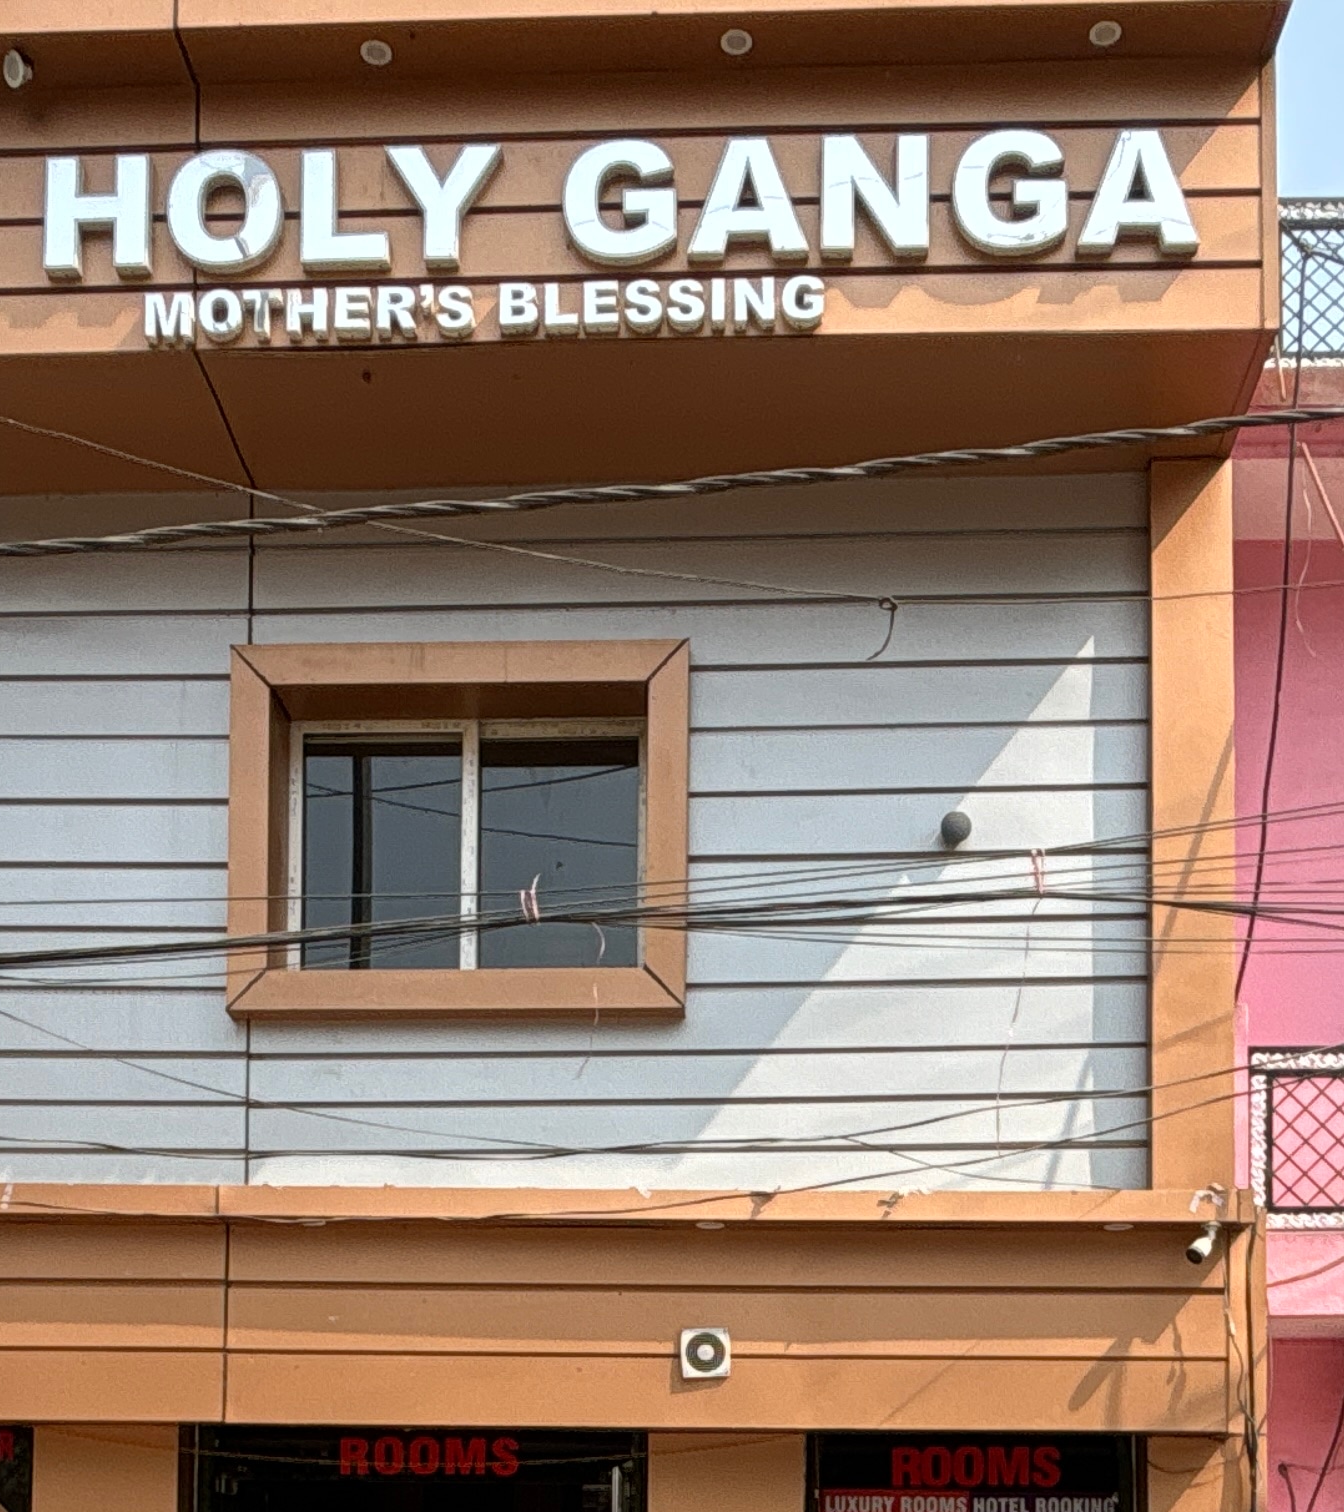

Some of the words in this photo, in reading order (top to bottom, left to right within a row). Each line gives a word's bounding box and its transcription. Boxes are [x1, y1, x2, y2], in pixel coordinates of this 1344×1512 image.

[43, 142, 504, 280] HOLY
[562, 128, 1199, 268] GANGA
[143, 284, 476, 348] MOTHER'S
[498, 275, 826, 337] BLESSING
[340, 1437, 520, 1476] ROOMS
[891, 1446, 1061, 1487] ROOMS
